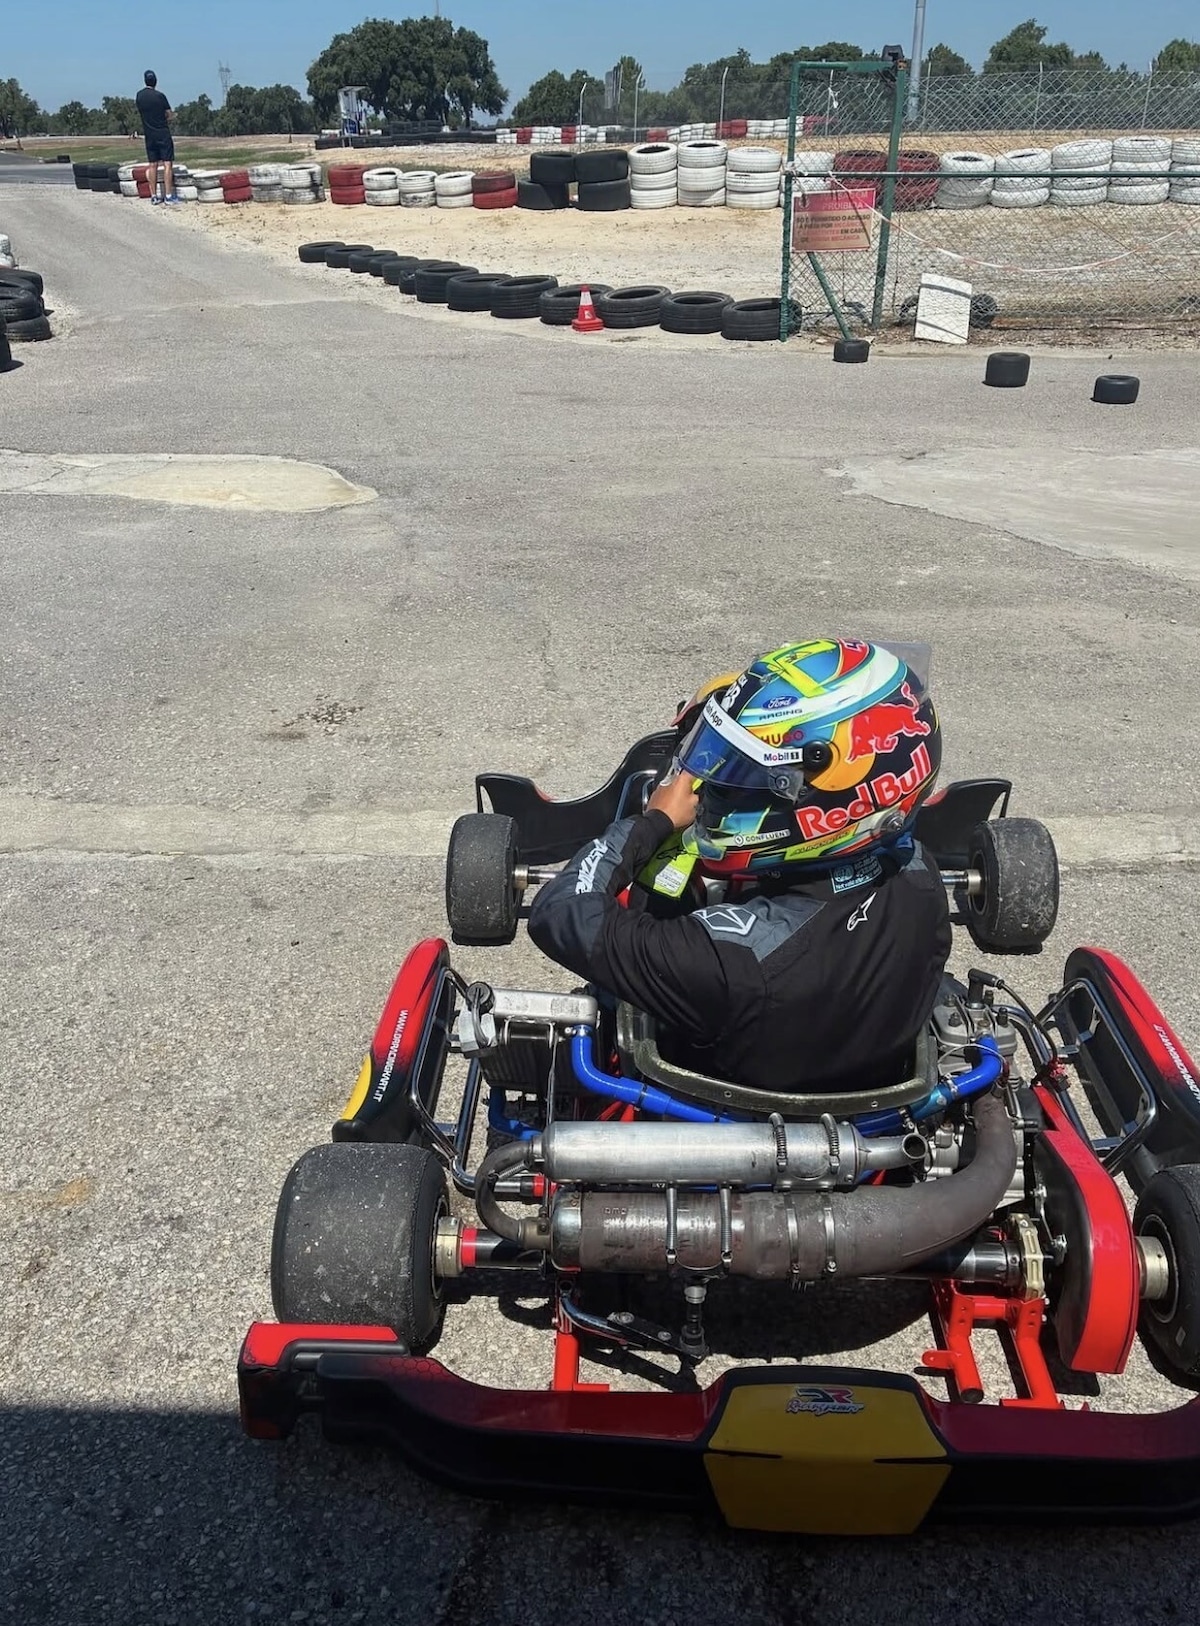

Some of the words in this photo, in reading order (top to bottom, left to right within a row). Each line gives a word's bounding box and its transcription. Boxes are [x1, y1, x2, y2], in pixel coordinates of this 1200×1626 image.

[767, 696, 792, 709] Ford
[710, 710, 723, 727] App
[759, 709, 803, 721] RACING
[763, 752, 789, 762] Mobil
[795, 780, 875, 841] Red
[871, 742, 932, 806] Bull
[745, 829, 790, 843] CONFLUENT
